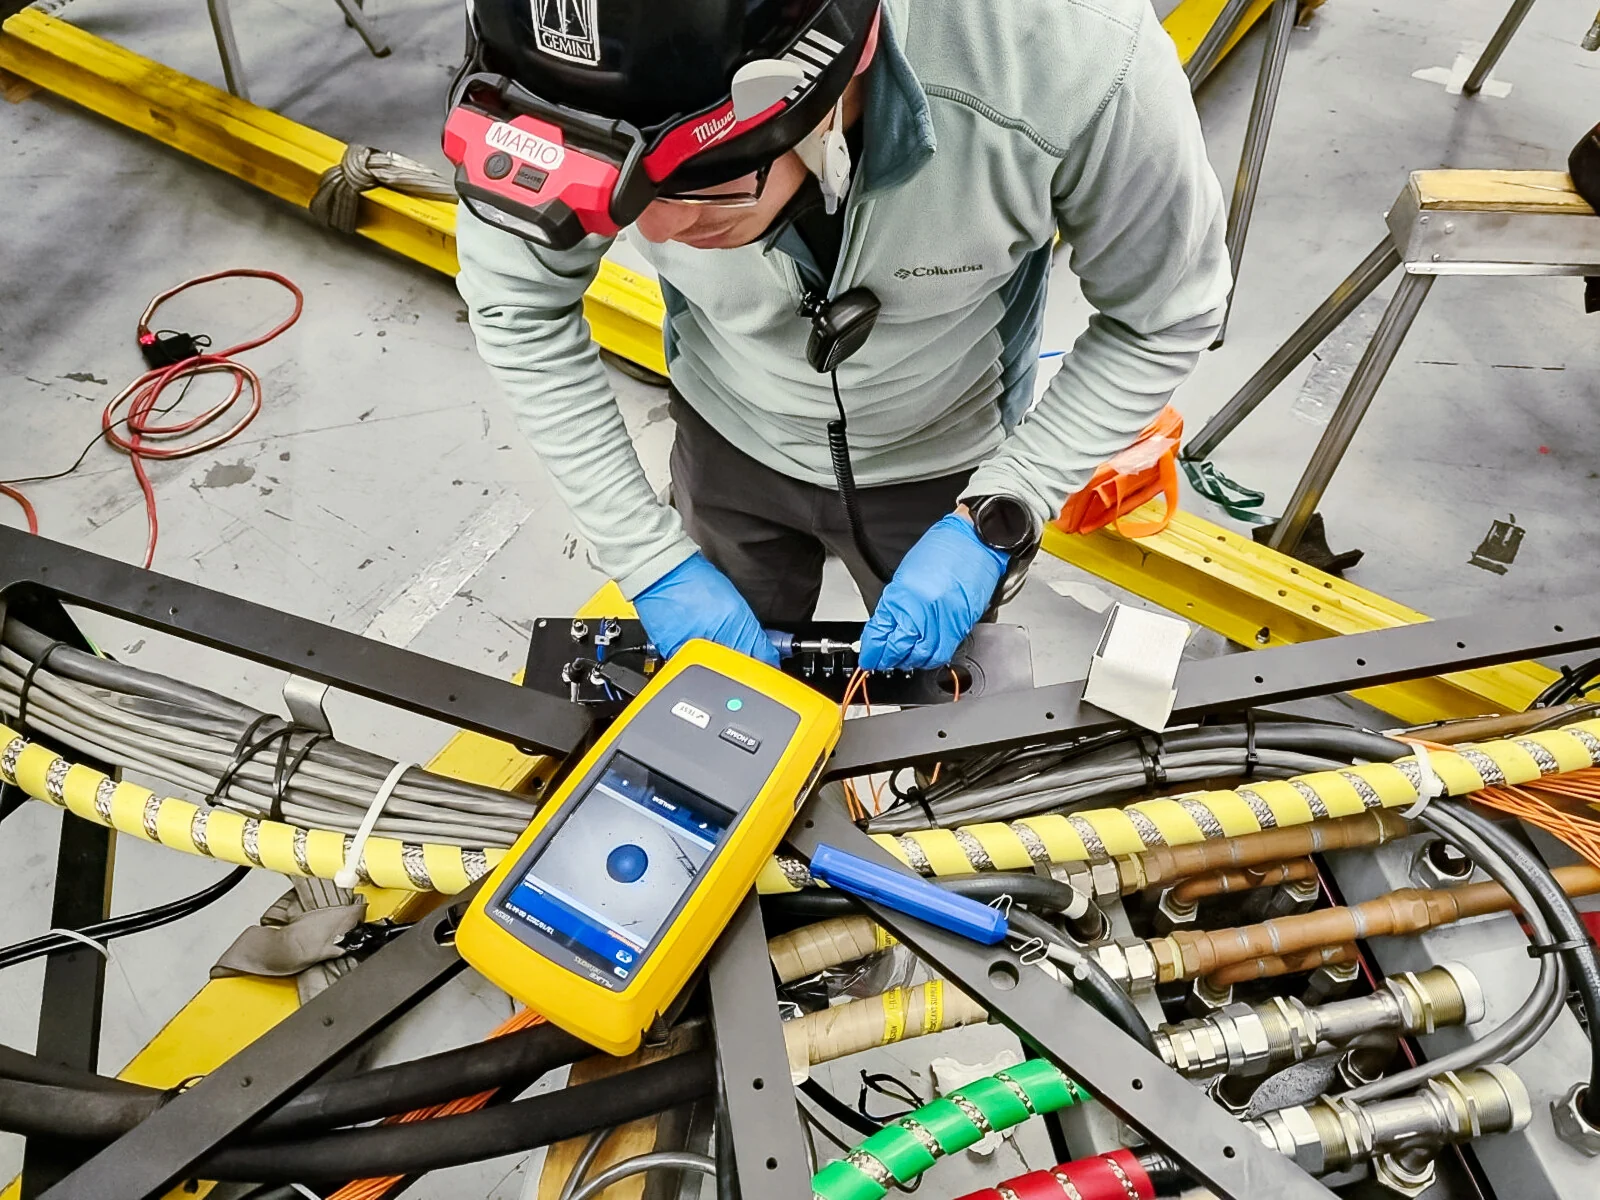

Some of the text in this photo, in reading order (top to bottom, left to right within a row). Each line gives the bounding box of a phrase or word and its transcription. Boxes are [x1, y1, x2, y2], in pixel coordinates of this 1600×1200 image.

[542, 32, 592, 59] GEMINI
[691, 110, 736, 143] Milwa
[491, 126, 558, 165] MARIO
[912, 264, 983, 277] Columbia
[680, 706, 695, 717] TEST
[725, 728, 749, 743] HOME
[589, 972, 614, 988] FLUKE
